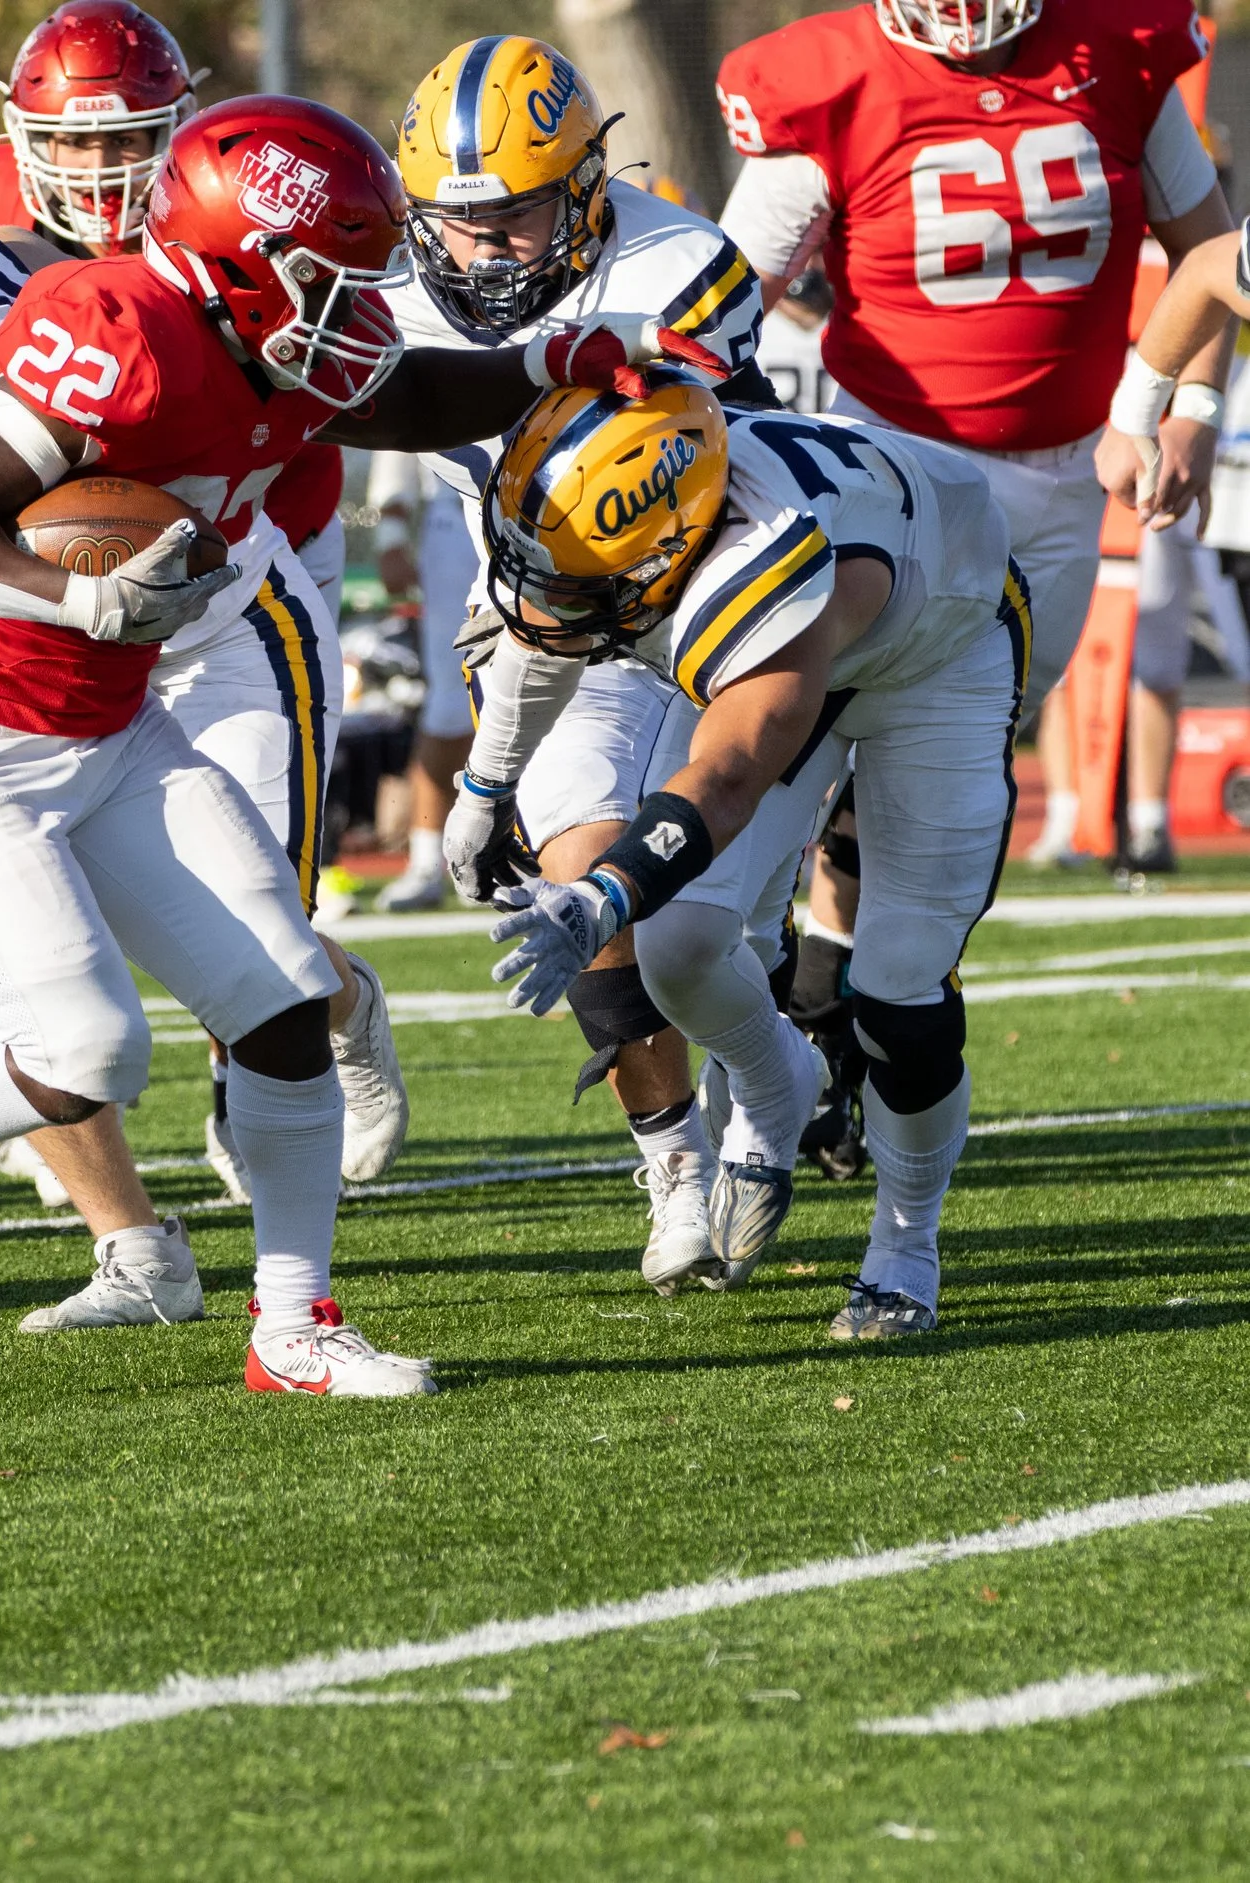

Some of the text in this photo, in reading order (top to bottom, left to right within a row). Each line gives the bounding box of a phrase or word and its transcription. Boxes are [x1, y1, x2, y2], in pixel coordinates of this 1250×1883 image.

[74, 99, 115, 112] BEARS
[234, 151, 330, 228] WASH
[911, 120, 1112, 307] 69
[412, 219, 449, 260] Riddell
[6, 317, 121, 427] 22
[595, 436, 696, 537] Augie
[570, 895, 588, 950] adidas
